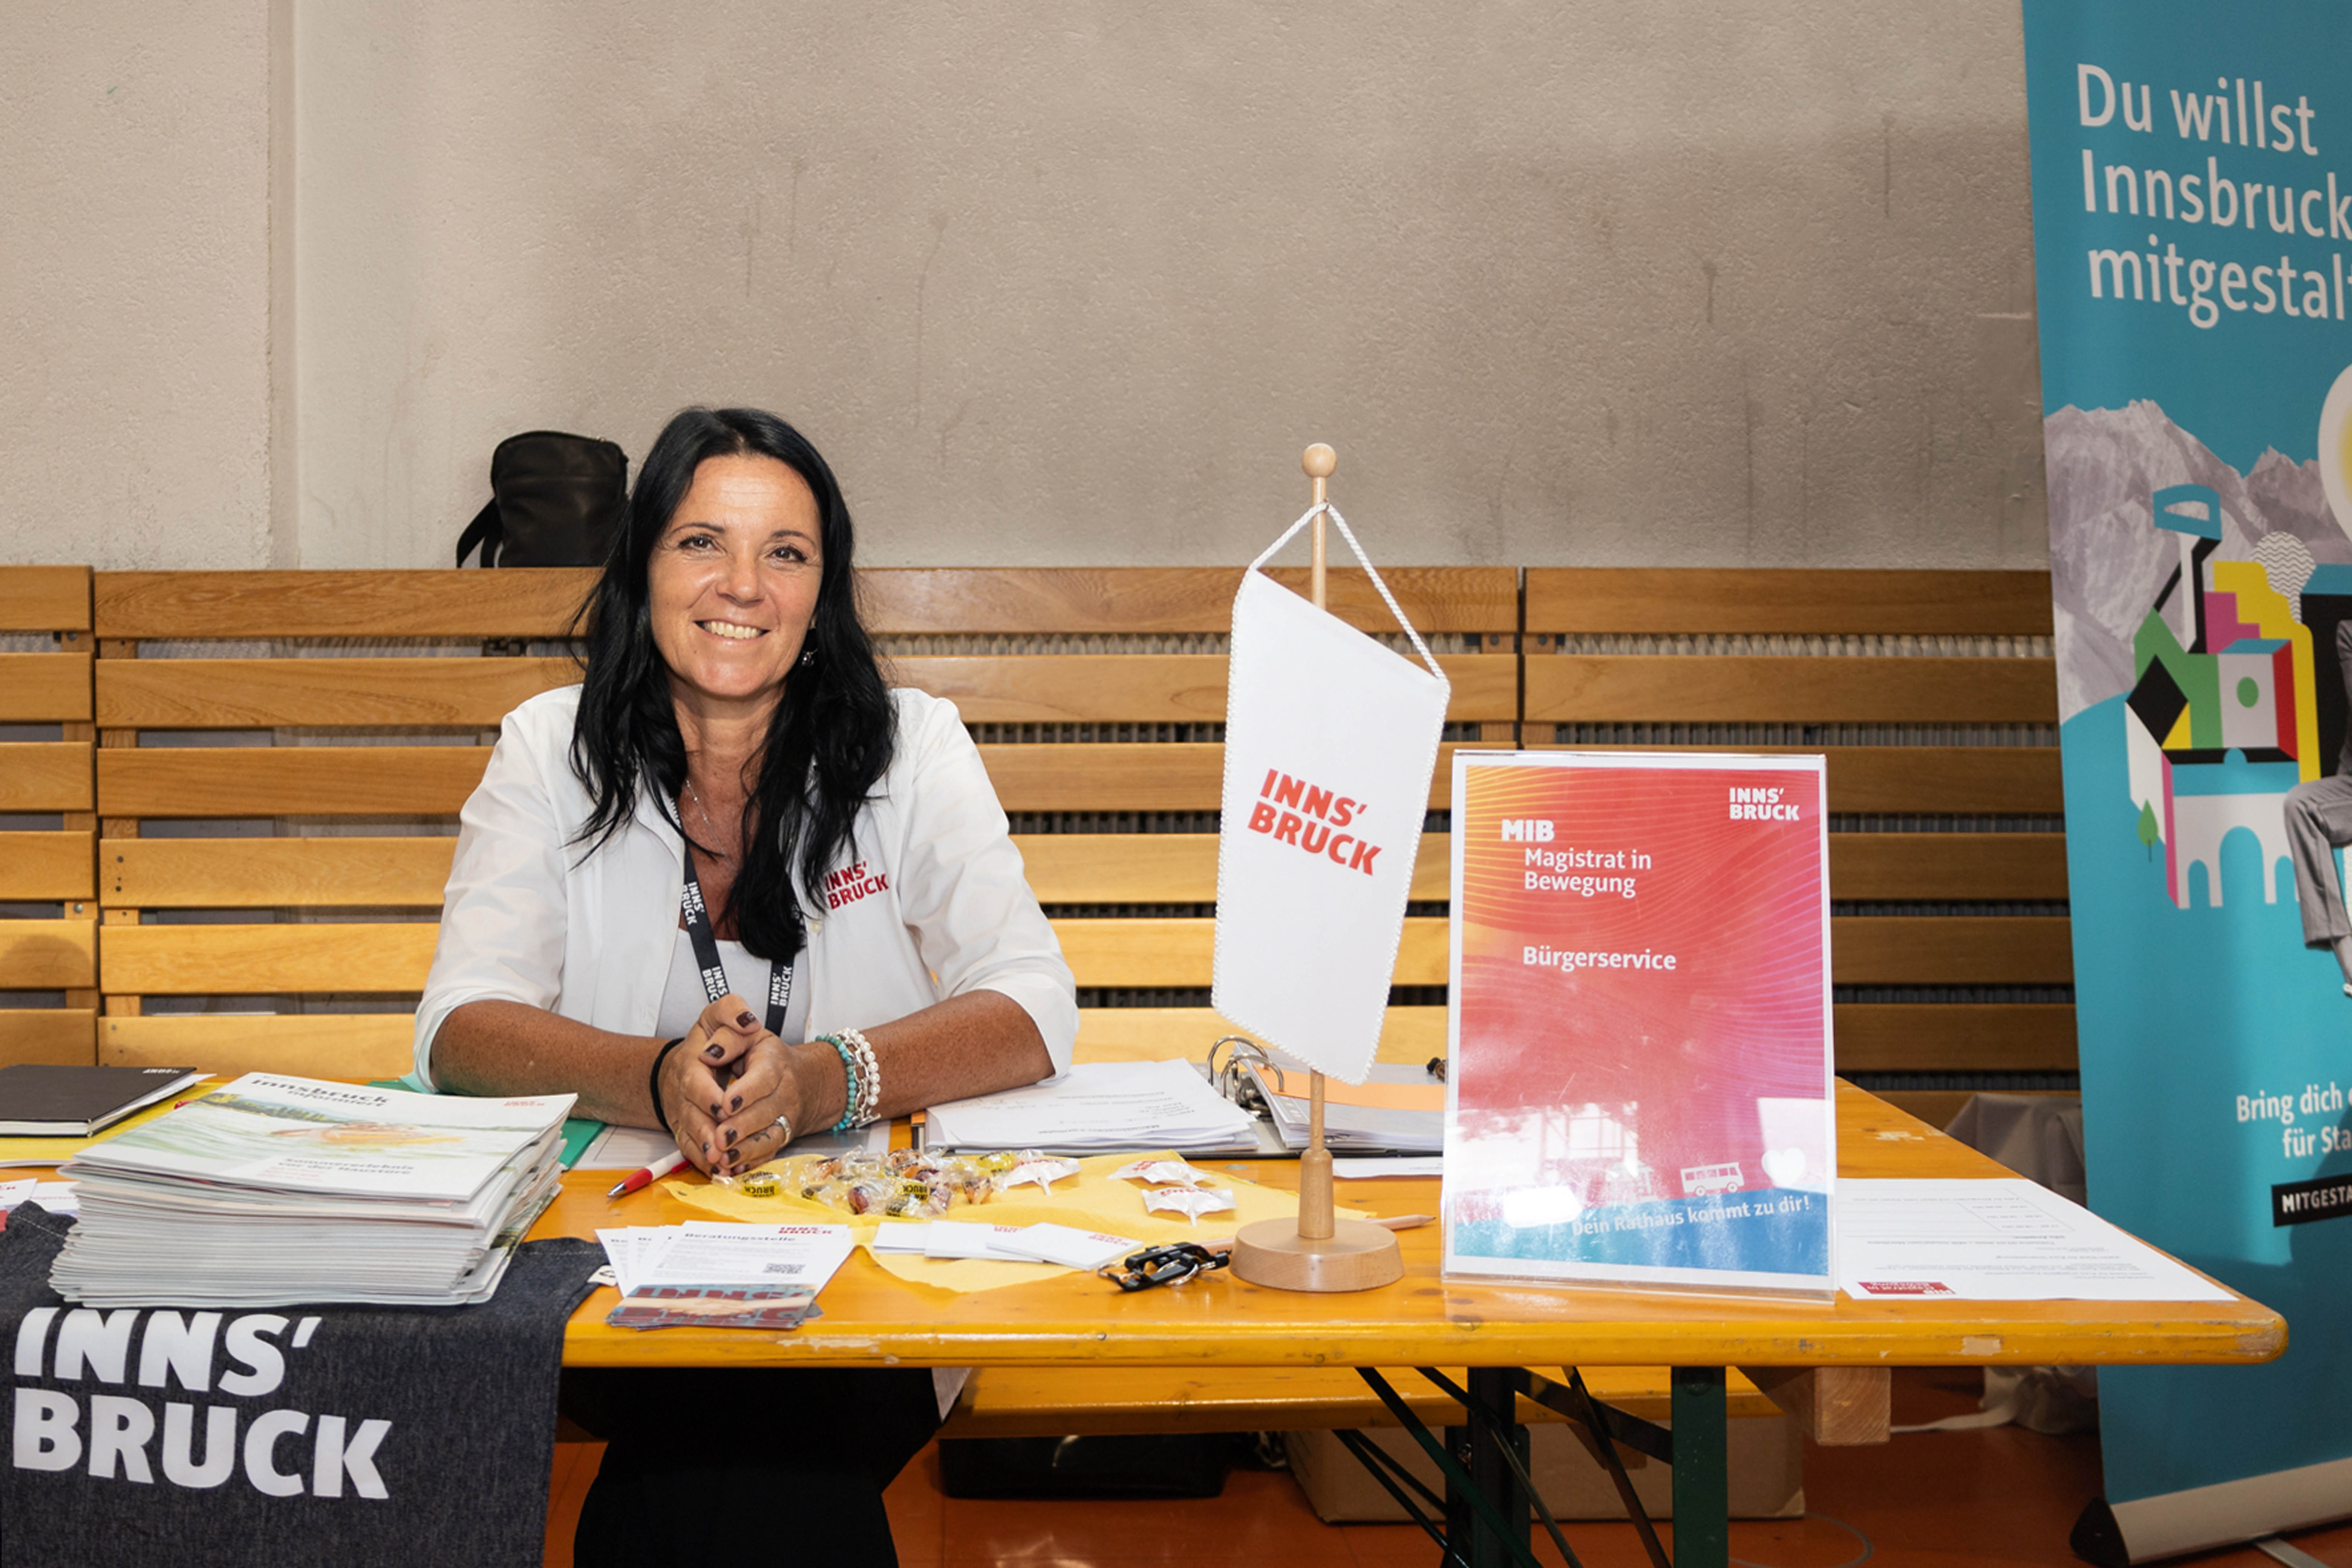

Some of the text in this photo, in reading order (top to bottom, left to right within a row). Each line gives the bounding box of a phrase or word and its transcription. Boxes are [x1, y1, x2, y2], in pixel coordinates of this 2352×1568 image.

[2077, 63, 2318, 156] Du willst
[2081, 149, 2352, 241] Innsbruck
[1260, 768, 1368, 827] INNS'
[1729, 788, 1784, 804] INNS'
[1729, 804, 1800, 821] BRUCK
[1248, 801, 1382, 876] BRUCK
[1501, 819, 1555, 842] MIB
[1525, 848, 1651, 873] Magistrat in
[828, 873, 889, 910] BRUCK
[1525, 871, 1636, 898] Bewegung
[1523, 946, 1676, 972] Bürgerservice
[702, 968, 720, 1003] BRUC
[712, 966, 728, 995] INNS
[779, 965, 792, 1007] BRUCK
[251, 1079, 389, 1103] Innsbruck
[2236, 1089, 2294, 1125] Bring
[2300, 1081, 2342, 1115] dich
[2282, 1127, 2316, 1159] für
[1572, 1194, 1810, 1236] Dein Rathaus kommt zu dir!
[14, 1307, 322, 1396] INNS'
[13, 1387, 392, 1499] BRUCK
